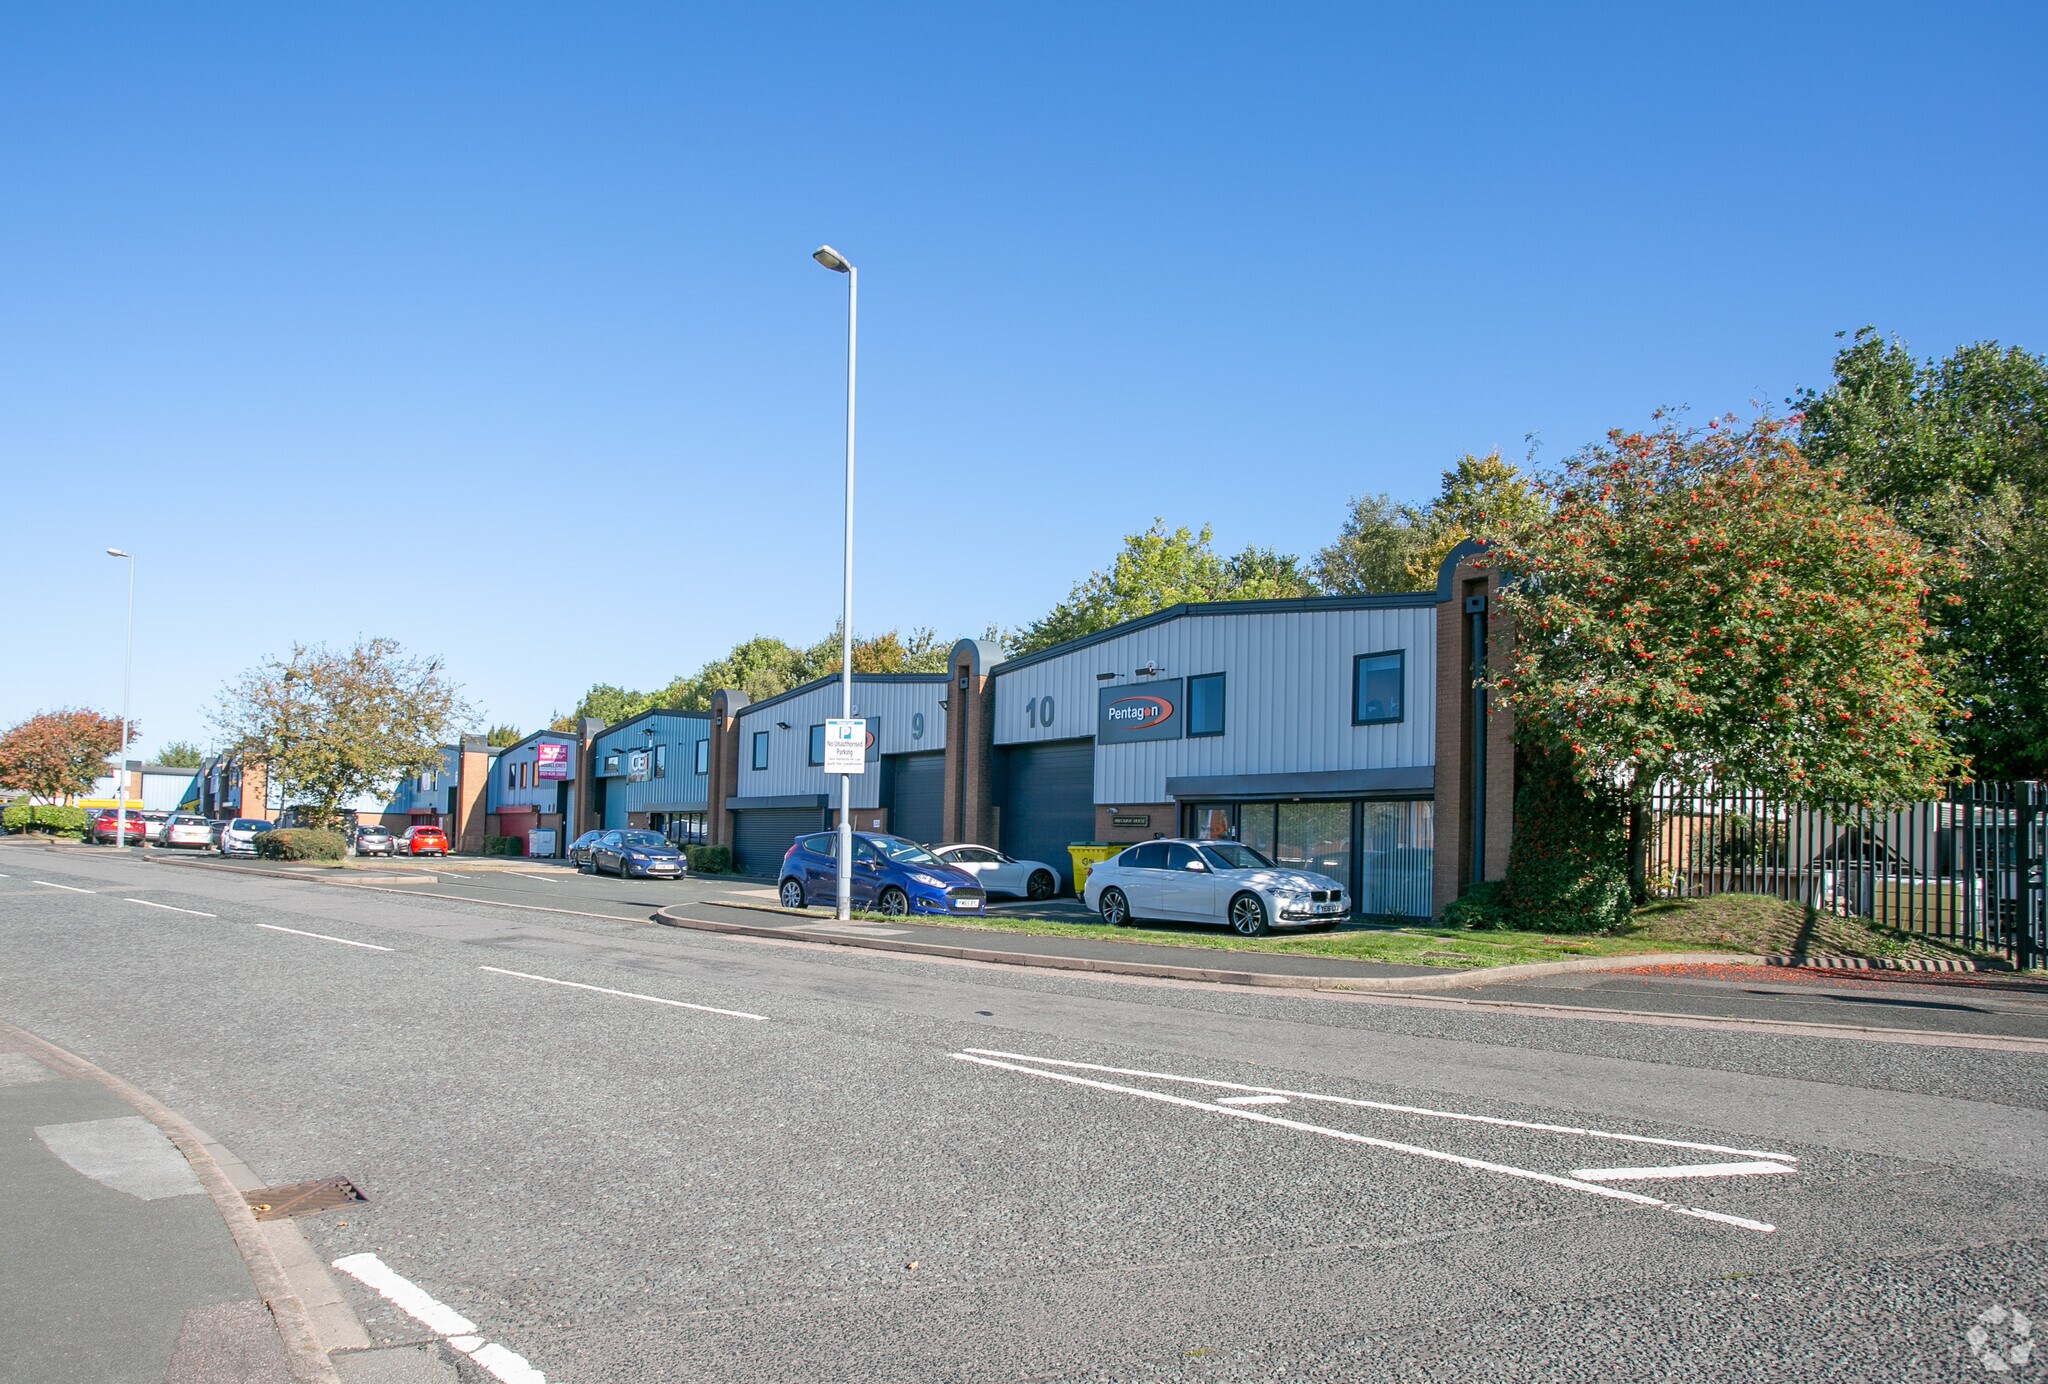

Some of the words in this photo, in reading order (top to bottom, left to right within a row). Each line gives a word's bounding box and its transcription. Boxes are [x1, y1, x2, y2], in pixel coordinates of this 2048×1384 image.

[1025, 695, 1055, 728] 10
[1108, 705, 1159, 721] Pentagon
[912, 712, 923, 740] 9
[834, 740, 863, 748] Unauthorised
[836, 748, 853, 757] Parking
